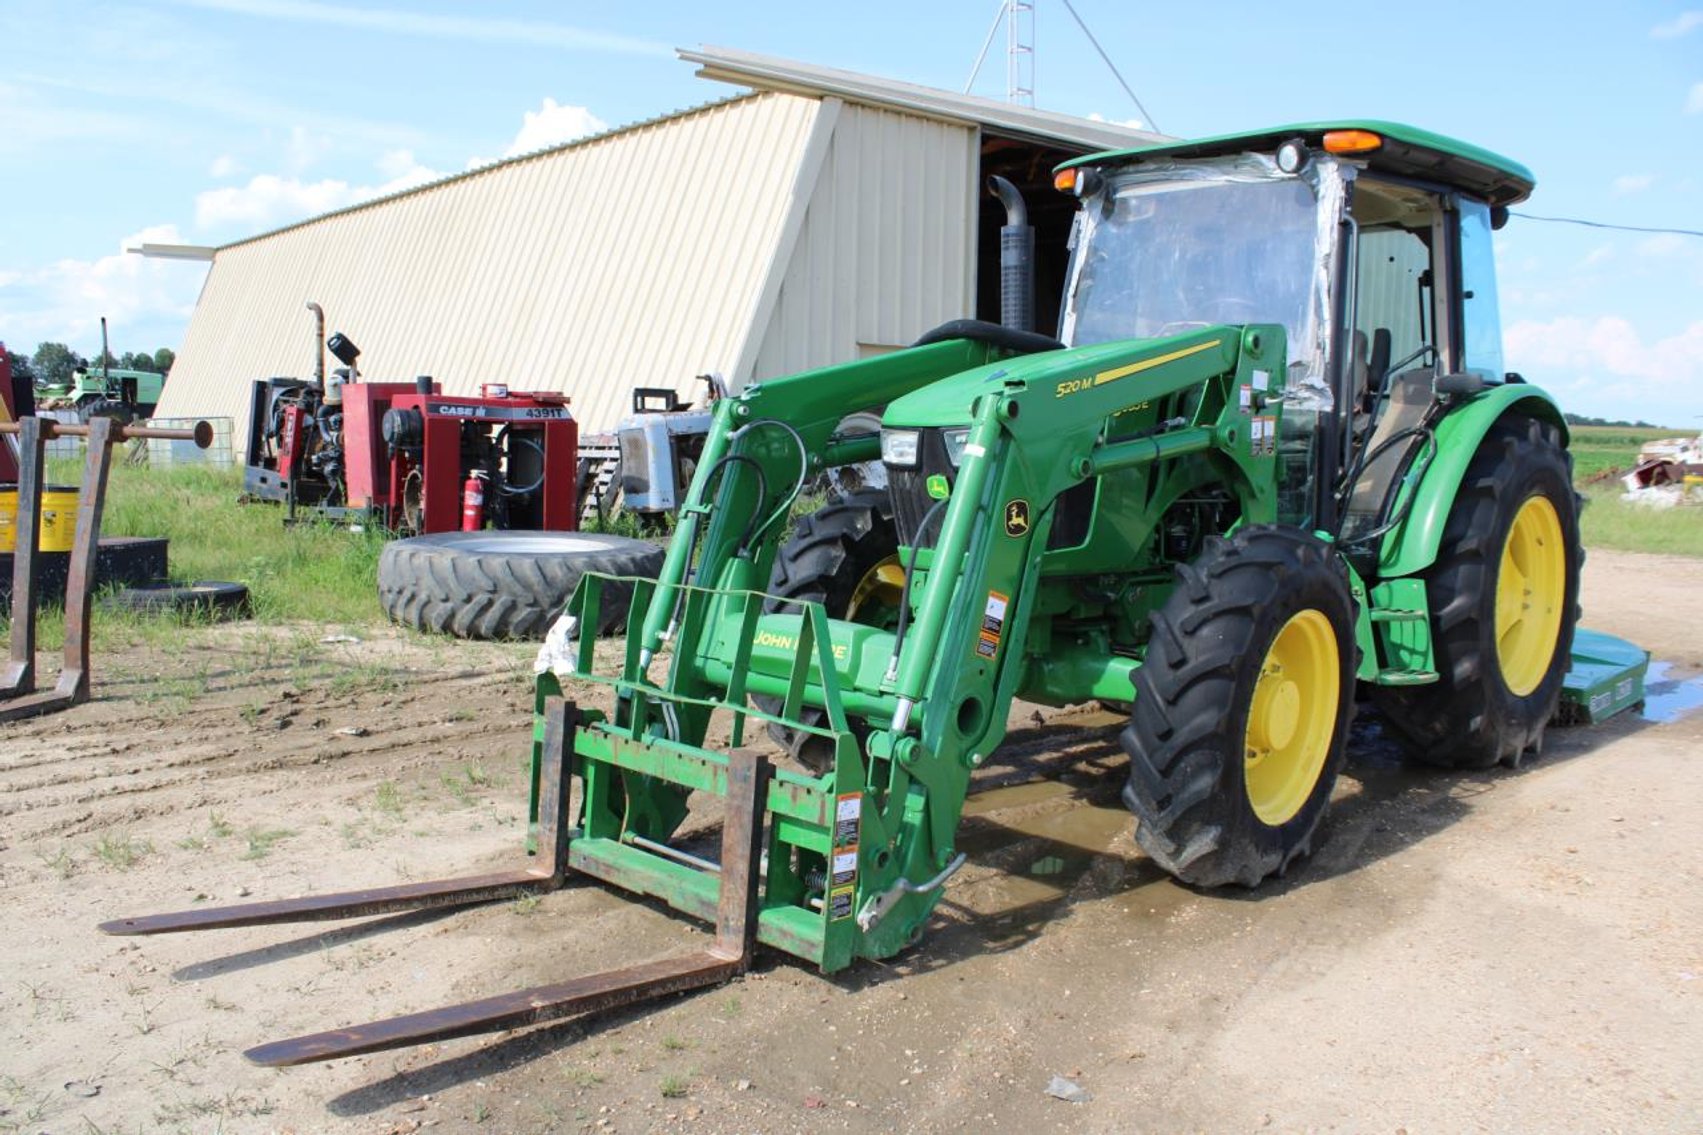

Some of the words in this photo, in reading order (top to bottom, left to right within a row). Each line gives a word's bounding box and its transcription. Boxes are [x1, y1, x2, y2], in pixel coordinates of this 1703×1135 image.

[1055, 380, 1080, 398] 520
[439, 405, 473, 416] CASE
[525, 407, 563, 418] 4391T
[753, 629, 792, 650] JOHN
